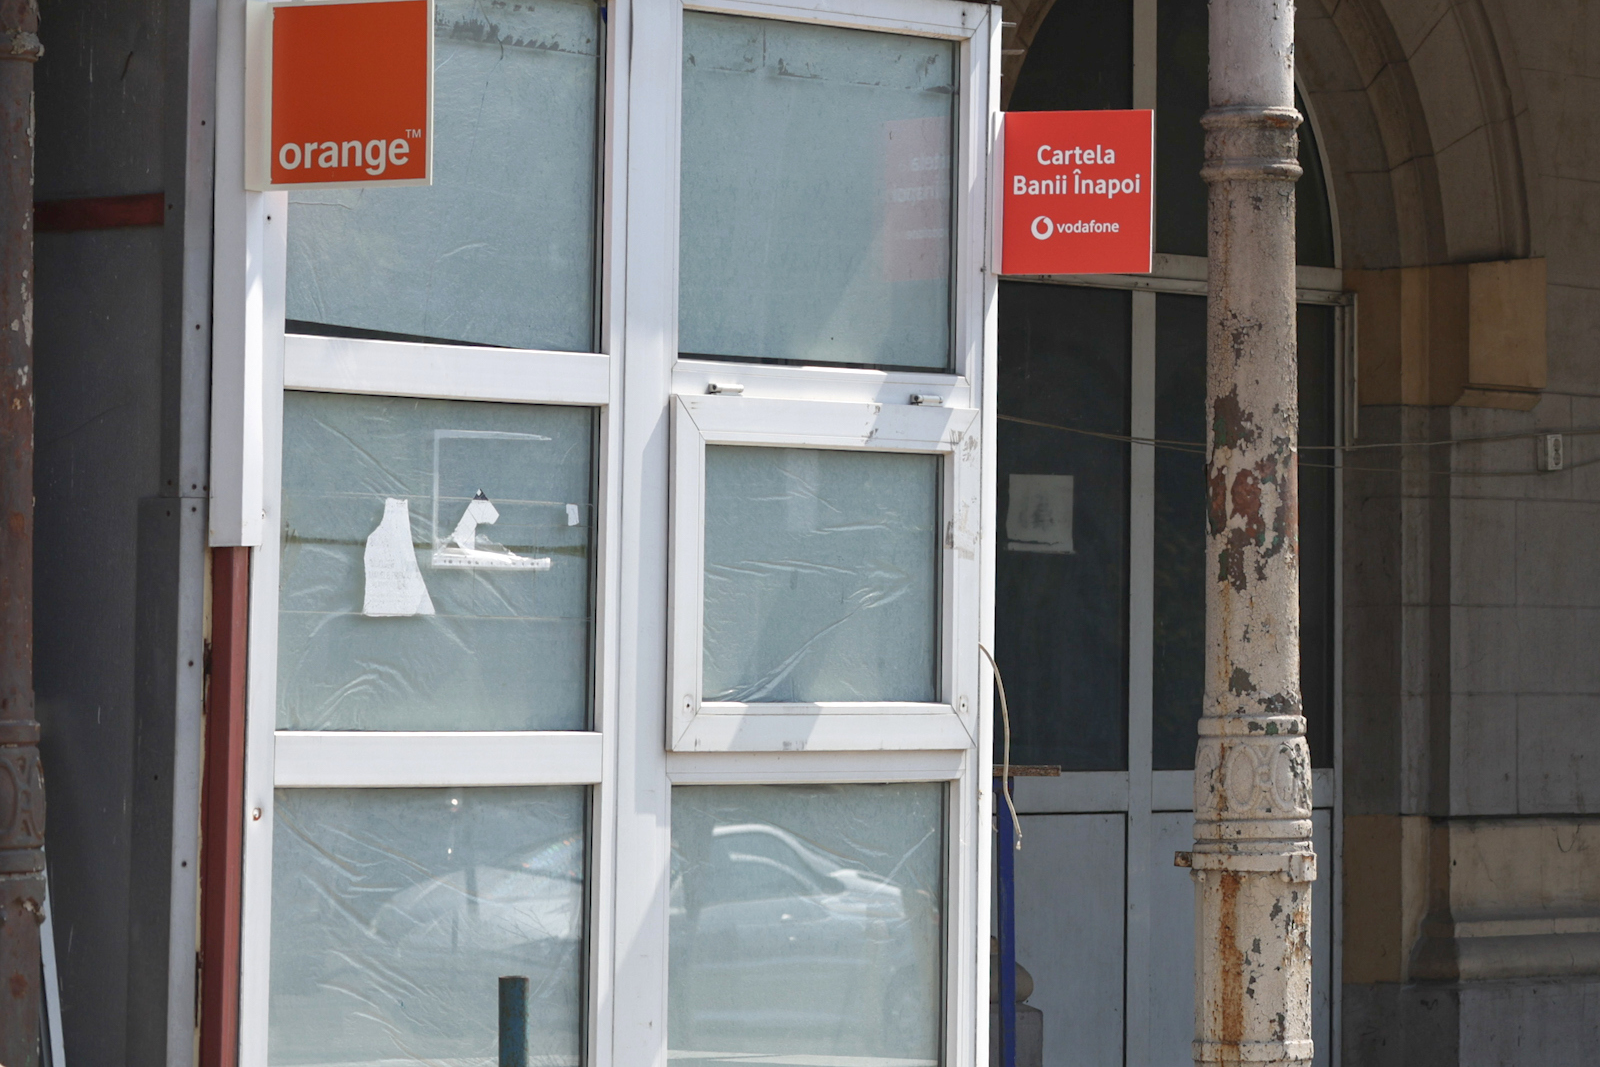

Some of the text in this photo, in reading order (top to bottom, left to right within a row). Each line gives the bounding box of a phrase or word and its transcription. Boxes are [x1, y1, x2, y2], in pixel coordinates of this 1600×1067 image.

[278, 138, 410, 176] orange
[1037, 144, 1116, 166] Cartela
[1013, 168, 1141, 199] Banii Înapoi
[1056, 219, 1120, 234] vodafone
